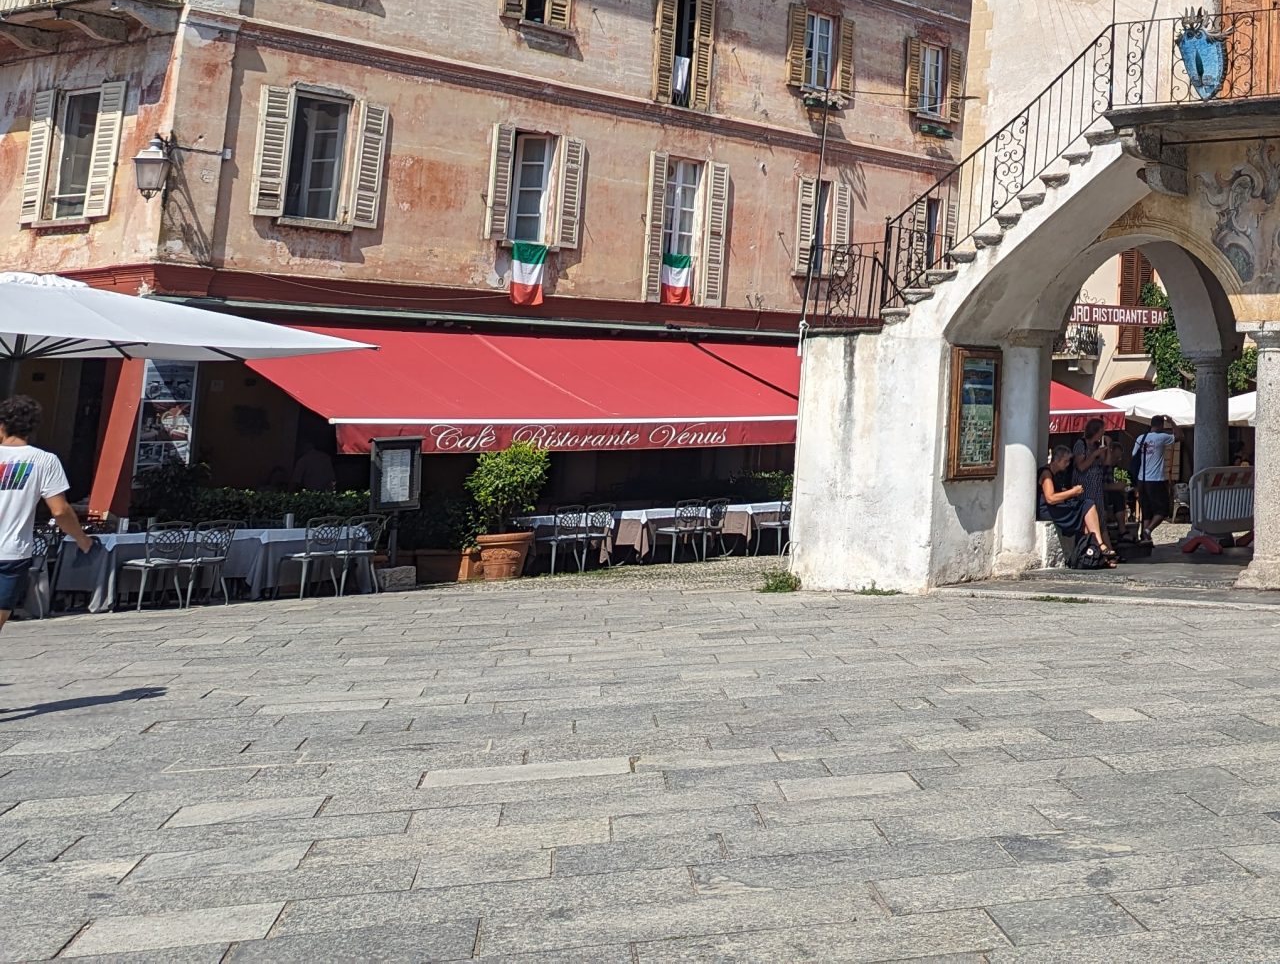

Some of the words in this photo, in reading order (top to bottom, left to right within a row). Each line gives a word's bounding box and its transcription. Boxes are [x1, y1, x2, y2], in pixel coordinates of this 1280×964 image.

[1092, 307, 1148, 324] RISTORANTE
[512, 424, 640, 450] Ristorante
[649, 423, 727, 447] Venus
